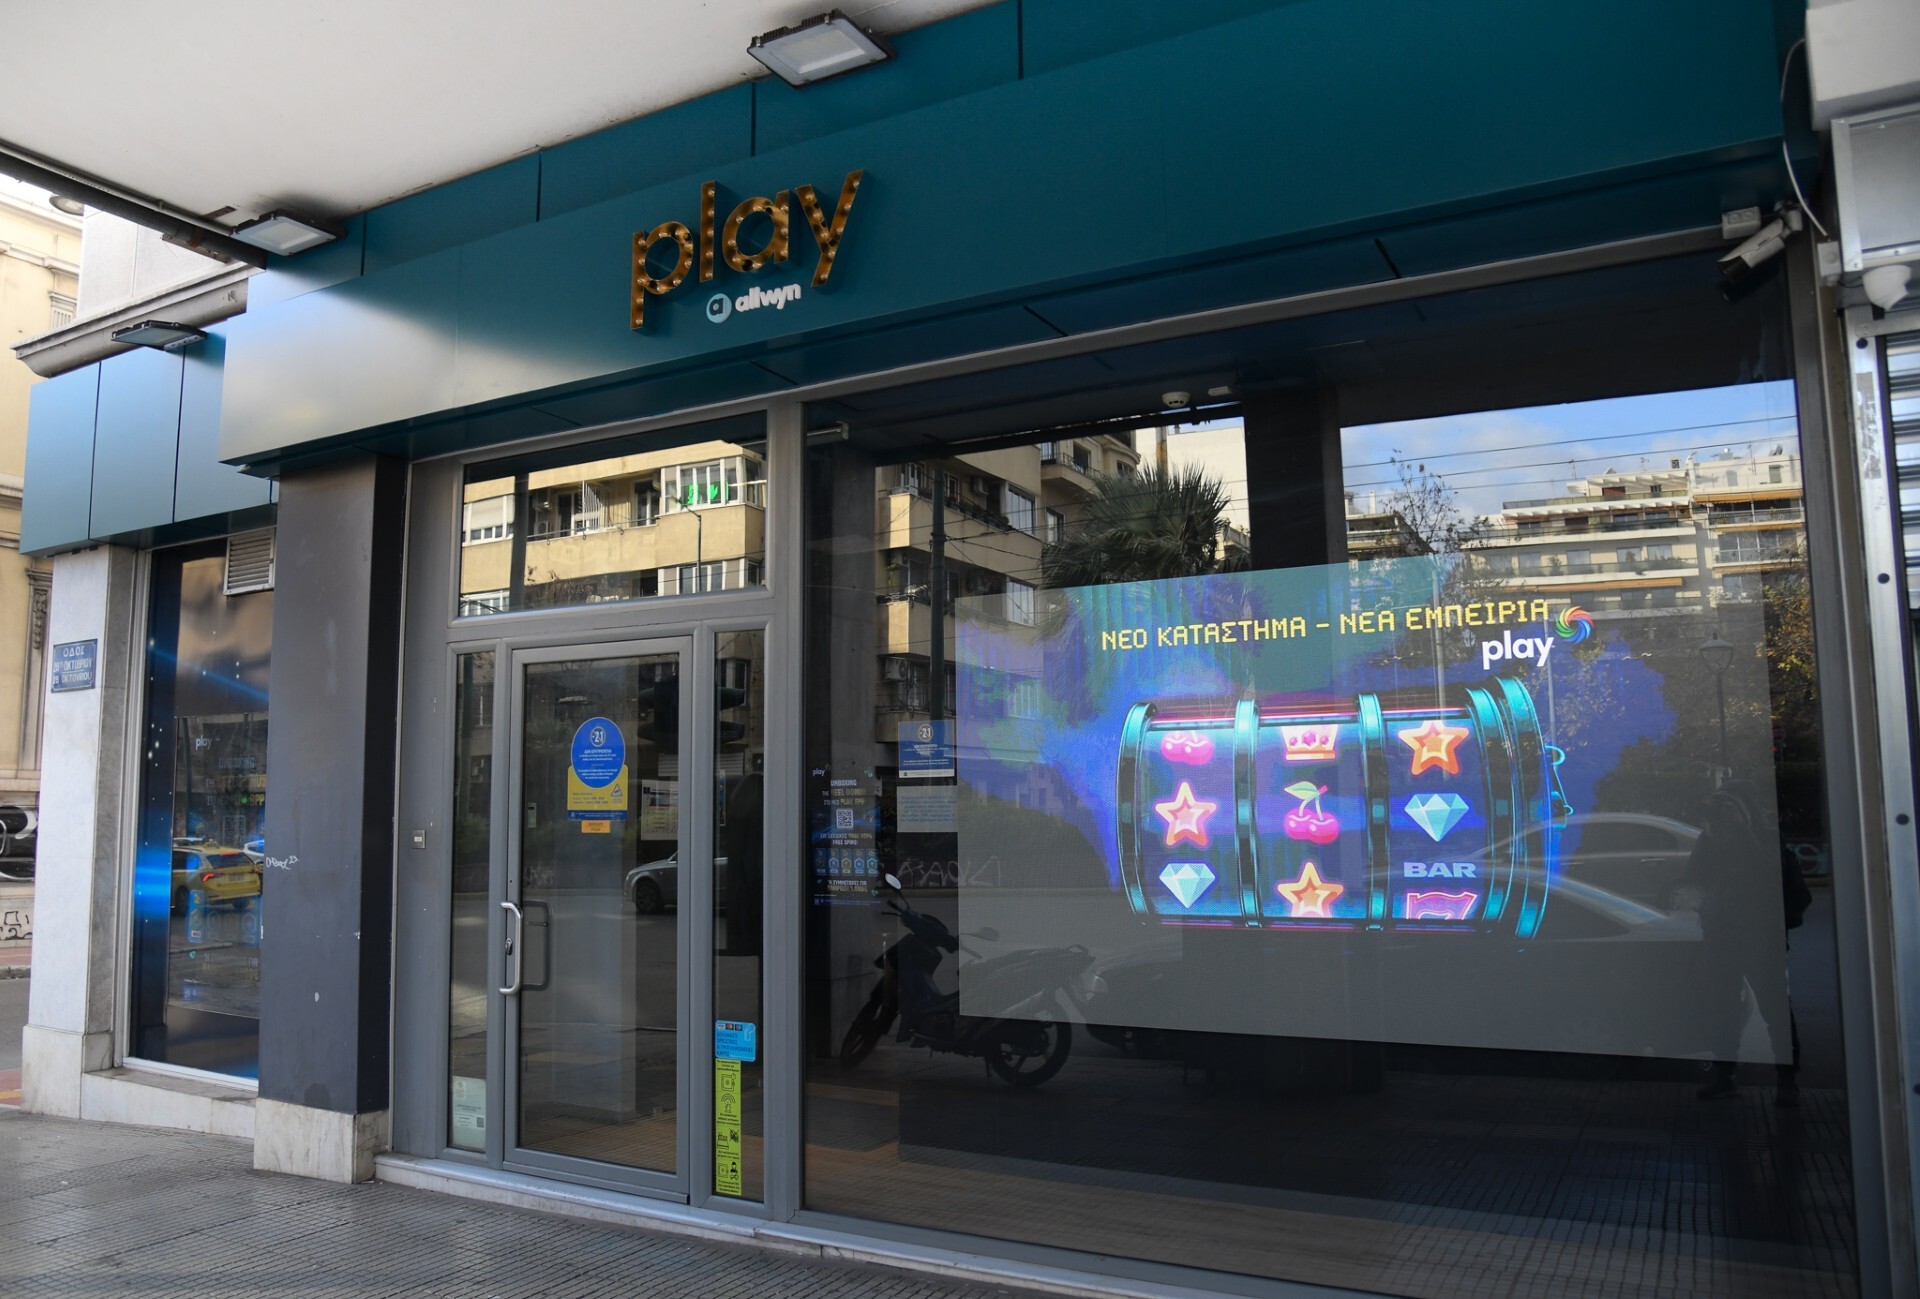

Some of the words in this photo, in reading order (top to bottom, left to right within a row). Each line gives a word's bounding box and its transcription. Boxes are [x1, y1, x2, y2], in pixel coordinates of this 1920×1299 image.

[630, 169, 864, 331] play
[735, 283, 802, 313] allwyn
[1101, 627, 1148, 651] ΝΕΟ
[1157, 616, 1306, 647] ΚΑΤΑΣΤΗΜΑ
[1340, 610, 1395, 636] ΝΕΑ
[1406, 598, 1549, 629] ΕΜΠΕΙΡΙΑ
[63, 646, 85, 658] ΟΔΟΣ
[1481, 629, 1555, 670] play
[1403, 861, 1477, 880] BAR
